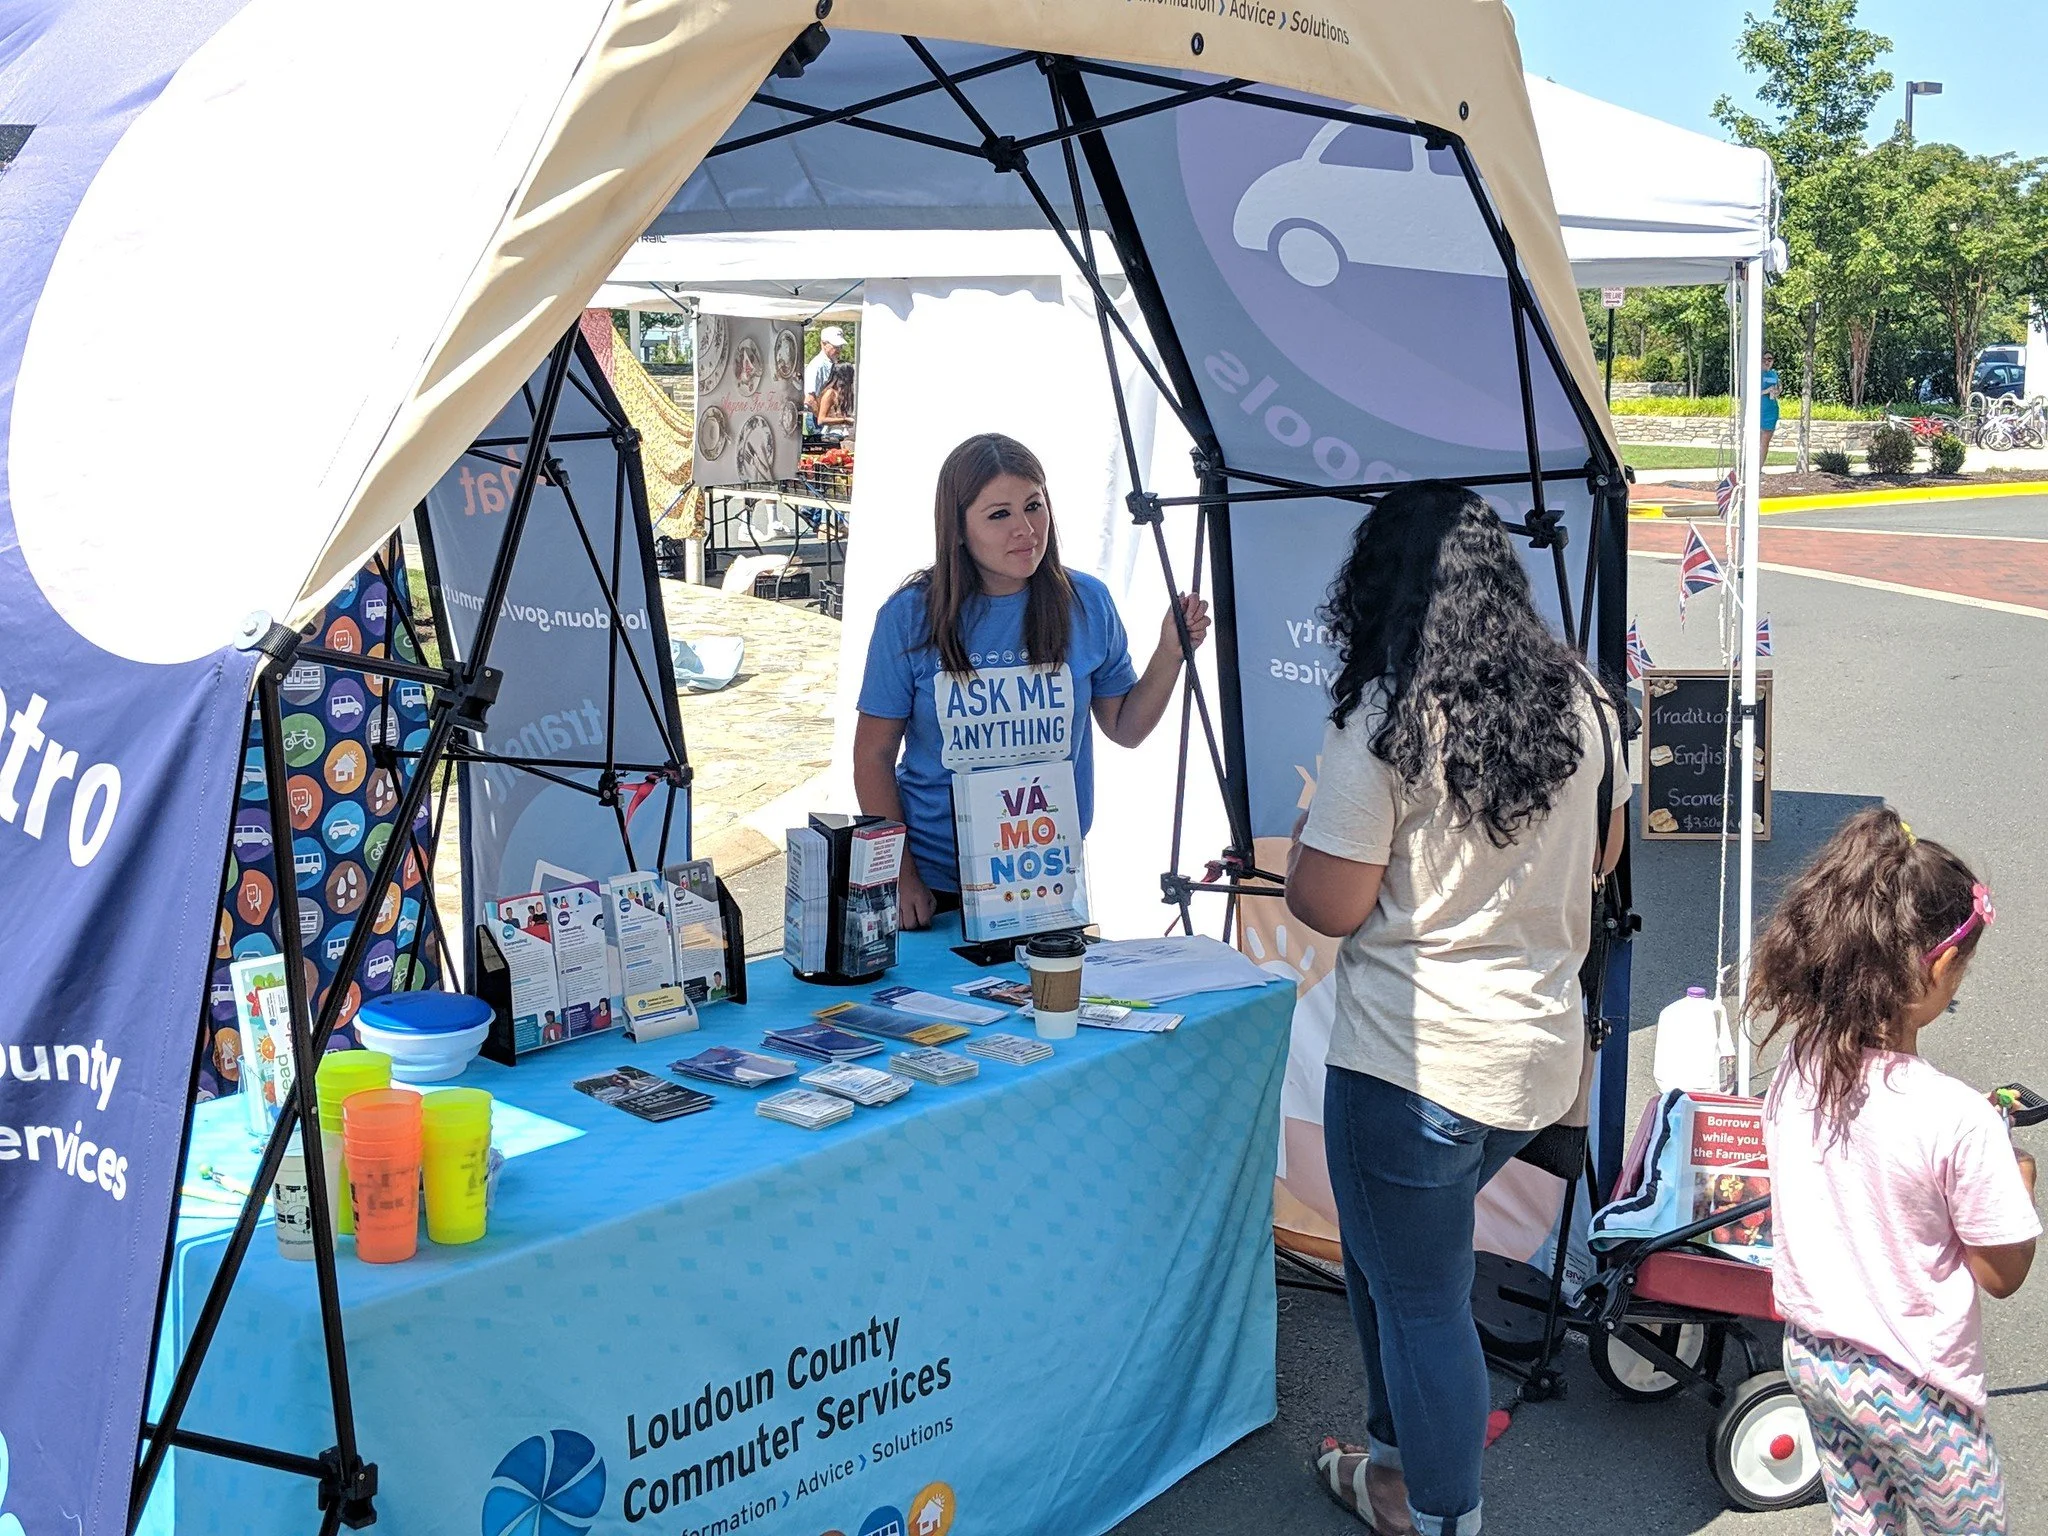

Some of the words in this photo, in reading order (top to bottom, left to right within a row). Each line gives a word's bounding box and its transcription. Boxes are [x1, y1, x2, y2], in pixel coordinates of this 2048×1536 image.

[1230, 0, 1276, 26] Advice
[1289, 10, 1350, 46] Solutions
[947, 677, 1012, 718] ASK
[1017, 672, 1065, 711] ME
[948, 716, 1065, 751] ANYTHING
[0, 686, 122, 868] tro
[1673, 743, 1734, 776] English
[1002, 776, 1049, 817] VÁ
[1668, 788, 1734, 806] Scones
[1000, 816, 1056, 851] MO
[990, 845, 1071, 885] NOS!
[0, 1039, 122, 1111] unty
[1702, 1132, 1735, 1144] while
[1736, 1136, 1759, 1147] you
[1707, 1115, 1751, 1129] Borrow
[1752, 1121, 1761, 1129] a
[1693, 1147, 1713, 1158] the
[627, 1367, 774, 1460] Loudoun
[787, 1315, 900, 1390] County
[623, 1414, 805, 1524] Commuter
[816, 1357, 952, 1440] Services
[796, 1457, 855, 1501] Advice
[871, 1415, 954, 1464] Solutions
